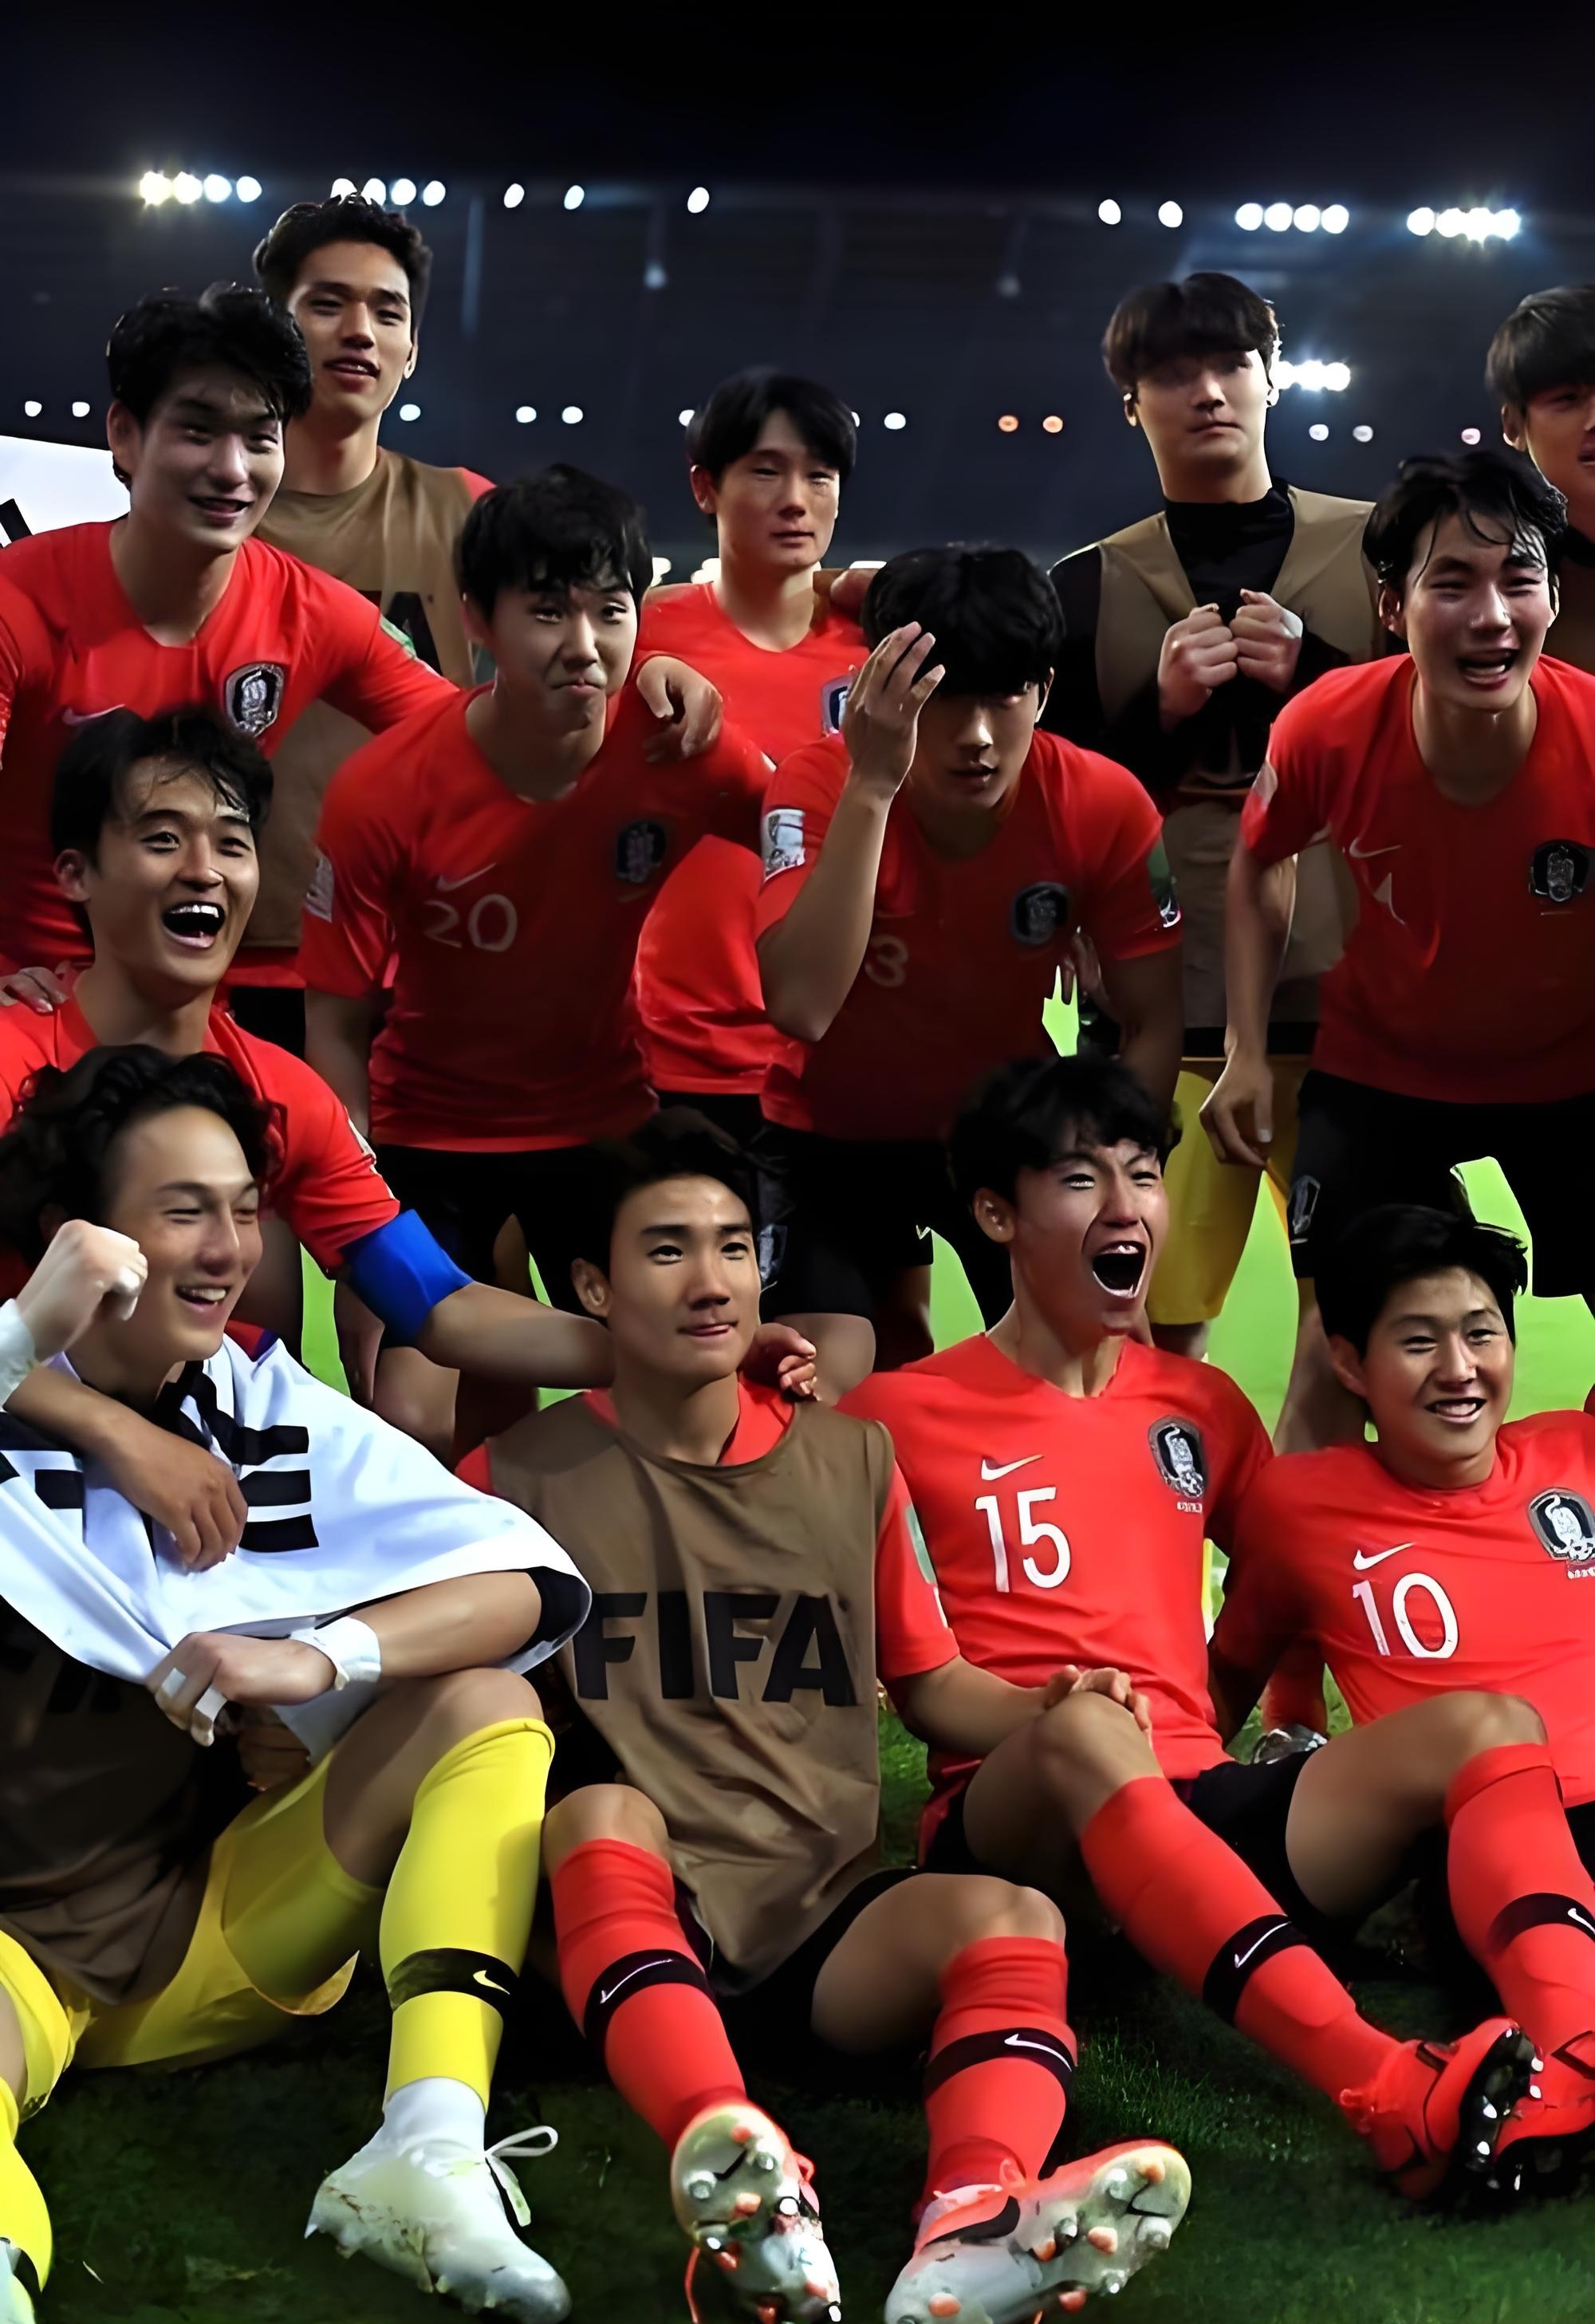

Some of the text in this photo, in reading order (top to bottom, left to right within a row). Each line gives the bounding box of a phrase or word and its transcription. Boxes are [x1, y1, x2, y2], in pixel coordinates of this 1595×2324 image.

[423, 893, 518, 952] 20
[975, 1487, 1071, 1593] 15
[573, 1590, 857, 1707] FIFA
[1353, 1573, 1459, 1659] 10
